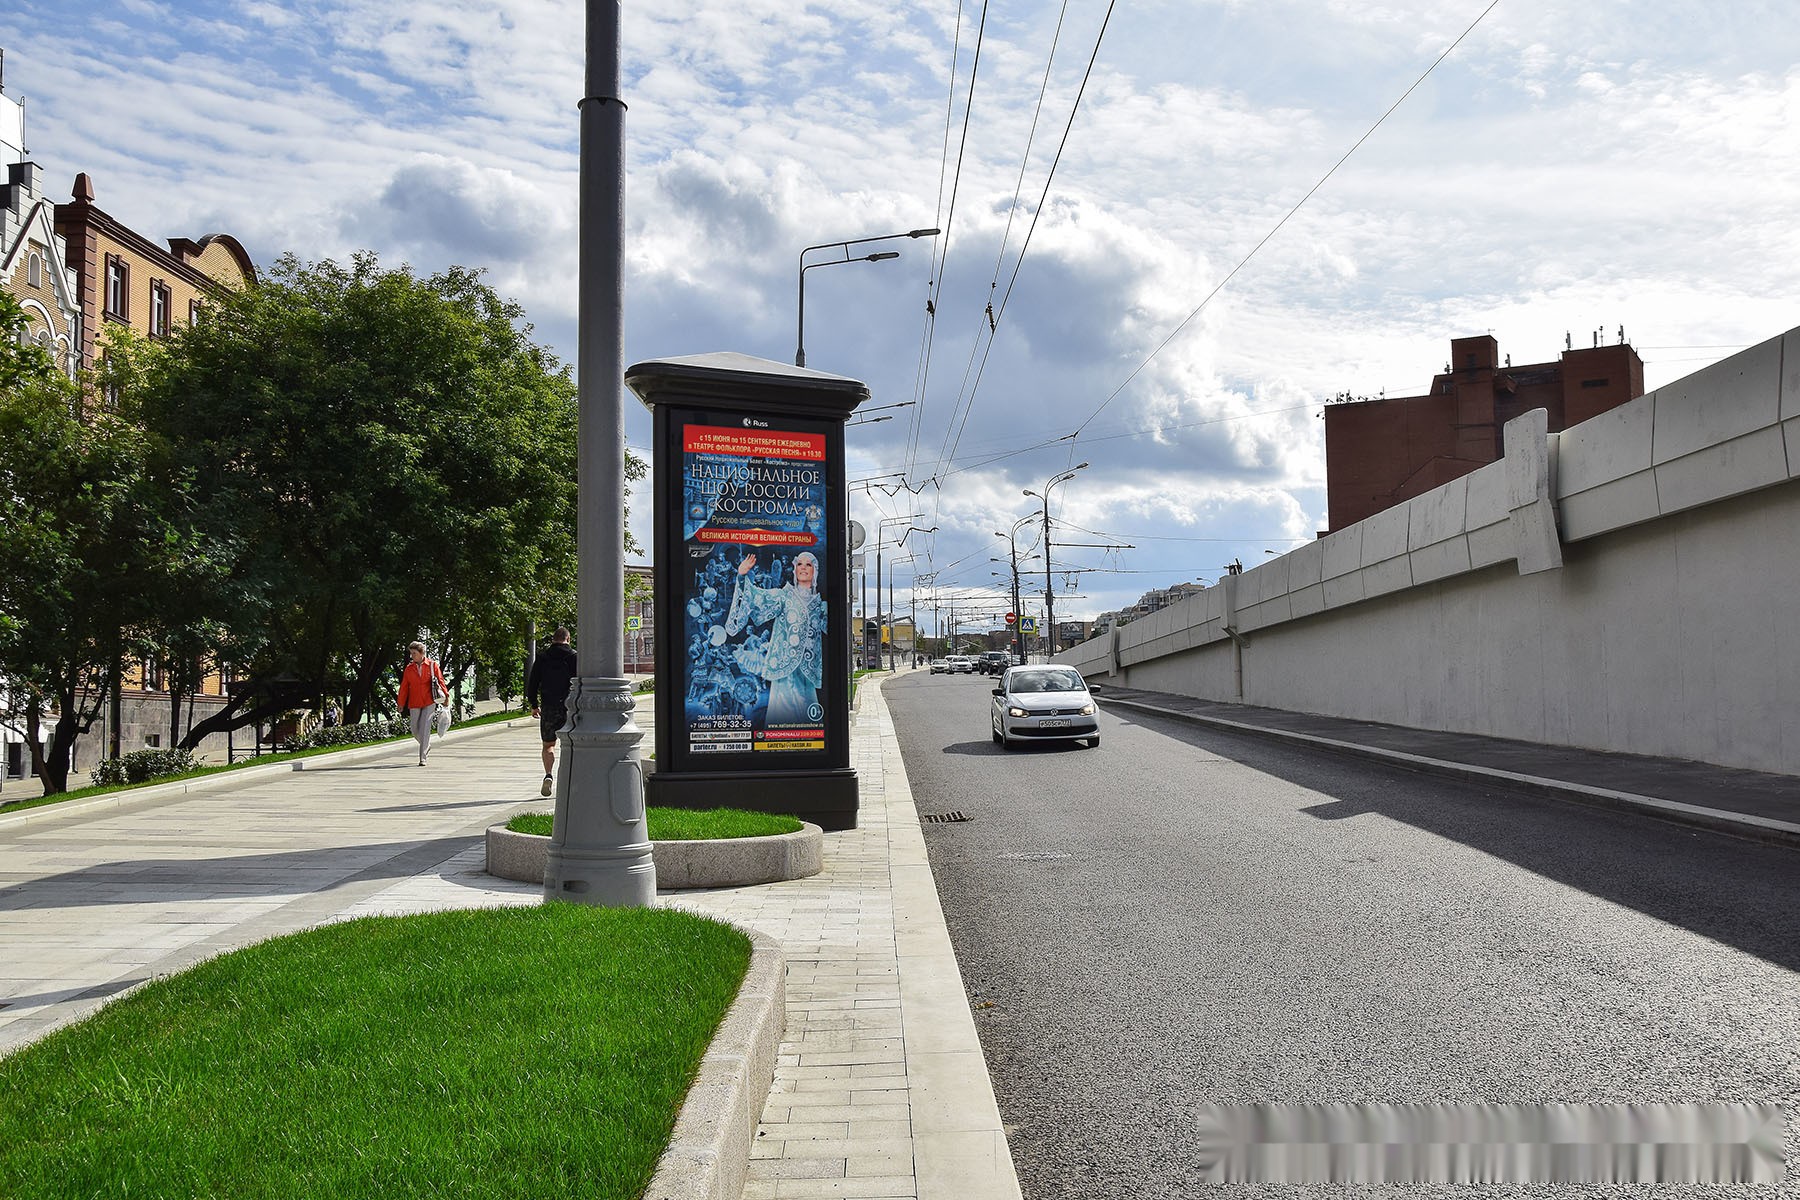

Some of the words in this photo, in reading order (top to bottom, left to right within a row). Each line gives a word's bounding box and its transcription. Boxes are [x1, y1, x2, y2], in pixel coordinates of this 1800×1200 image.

[694, 442, 714, 450] ТЕАТРЕ
[716, 444, 752, 453] ФОЛЬКЛОРА
[748, 437, 776, 446] СЕНТЯБРЯ
[778, 439, 811, 448] ЕЖЕДНЕВНО
[692, 464, 820, 484] НАЦИОНАЛЬНОЕ
[700, 481, 740, 497] ШОУ
[744, 484, 810, 500] РОССИИ
[709, 498, 803, 515] «КОСТРОМА»
[712, 516, 738, 525] Русское
[739, 517, 783, 526] танцевальное
[702, 532, 730, 540] ВЕЛИКАЯ
[730, 532, 758, 541] ИСТОРИЯ
[760, 533, 786, 542] ВЕЛИКОЙ
[788, 535, 812, 543] СТРАНЫ
